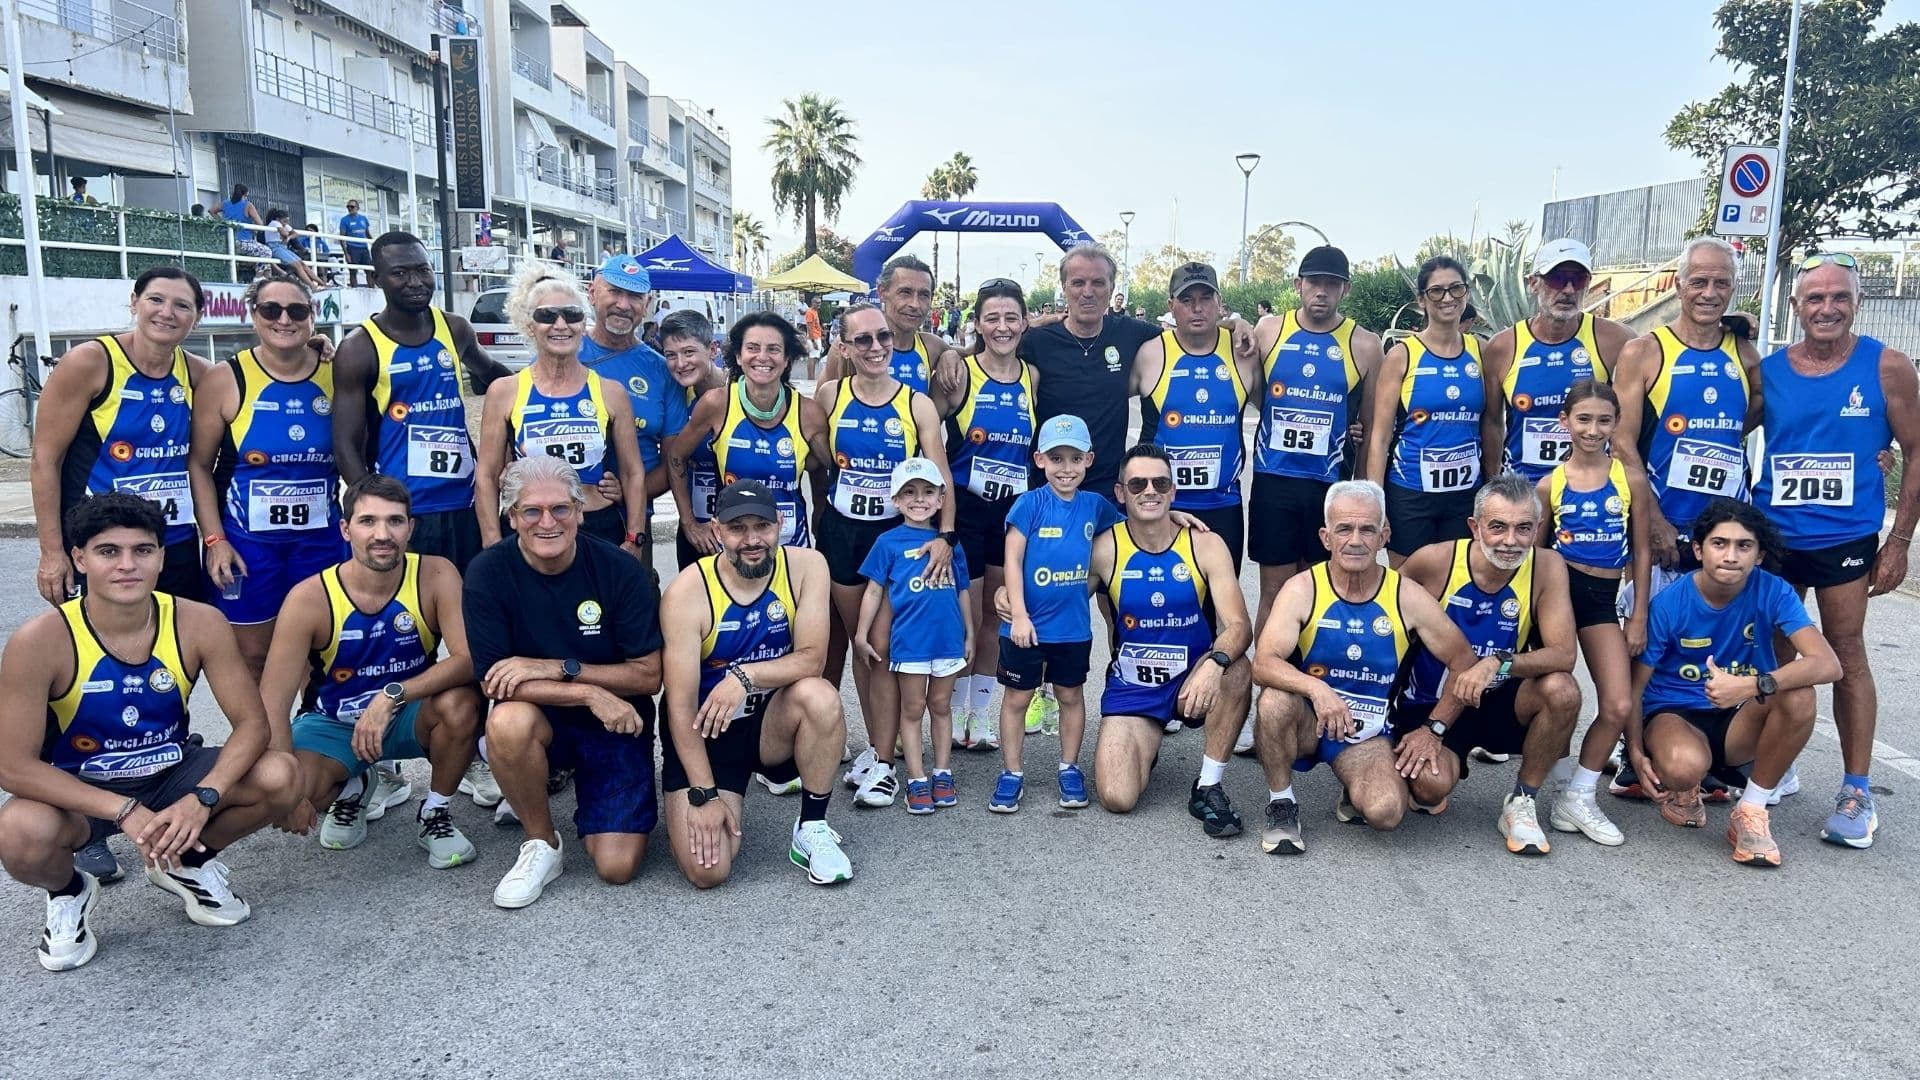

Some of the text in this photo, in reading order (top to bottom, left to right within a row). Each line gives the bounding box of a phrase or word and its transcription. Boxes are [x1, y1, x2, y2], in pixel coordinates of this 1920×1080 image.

[453, 79, 466, 129] LAGHI
[455, 132, 467, 149] DI
[465, 84, 482, 197] ASSOCIAZIONE
[1725, 207, 1738, 221] P
[1283, 428, 1315, 450] 93
[430, 450, 462, 474] 87
[546, 442, 585, 465] 83
[1539, 440, 1573, 462] 82
[1177, 466, 1209, 486] 95
[1430, 464, 1473, 489] 102
[1688, 464, 1728, 491] 99
[983, 480, 1013, 500] 90
[1780, 477, 1843, 501] 209
[161, 498, 179, 521] 4
[270, 503, 310, 526] 89
[850, 493, 884, 517] 86
[1137, 665, 1170, 685] 85
